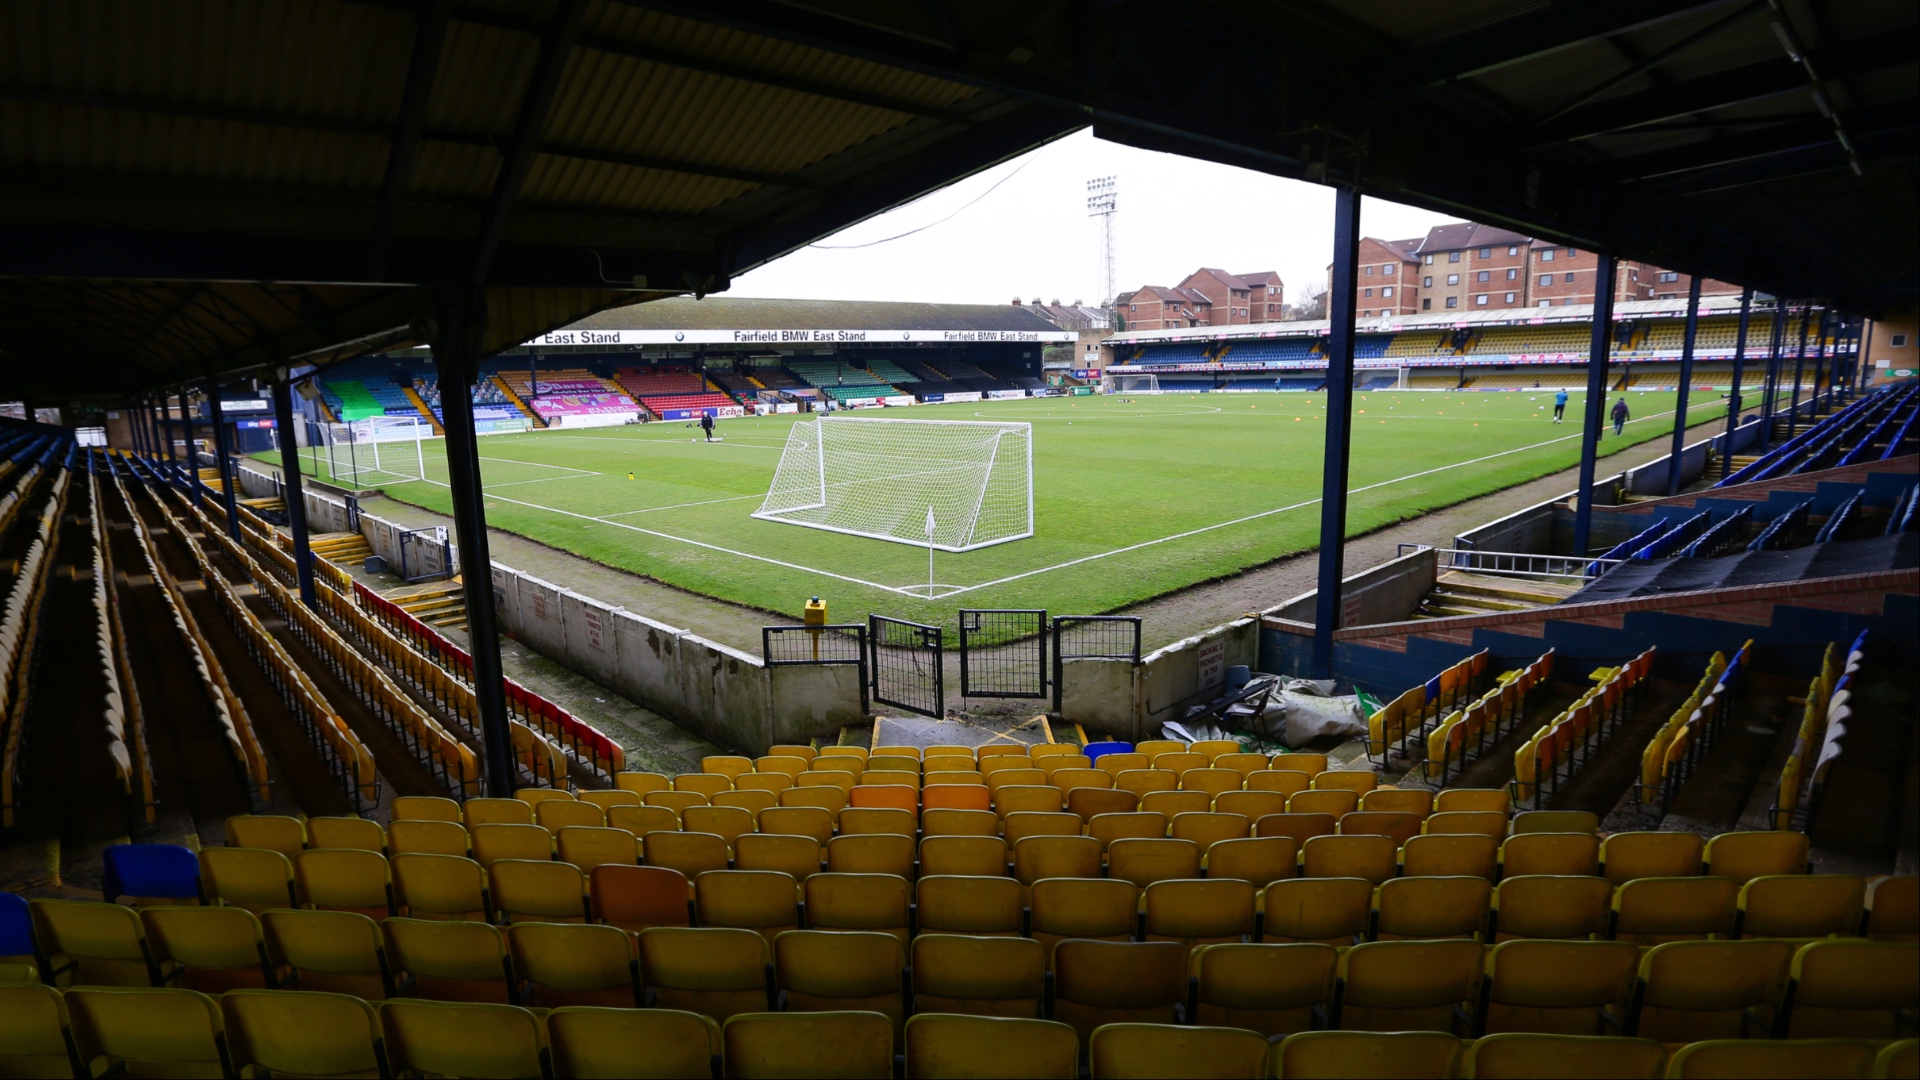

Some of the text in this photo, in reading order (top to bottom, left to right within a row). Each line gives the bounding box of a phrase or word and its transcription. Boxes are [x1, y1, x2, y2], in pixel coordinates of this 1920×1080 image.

[545, 332, 575, 344] East
[581, 331, 620, 343] Stand
[734, 330, 866, 342] Fairfield BMW East Stand
[944, 331, 1038, 341] Fairfield BMW East Stand
[1077, 370, 1087, 378] sky
[680, 410, 691, 418] sky
[719, 407, 742, 417] Echo
[1200, 644, 1218, 657] SMOKING
[1200, 653, 1223, 668] PROHIBITED
